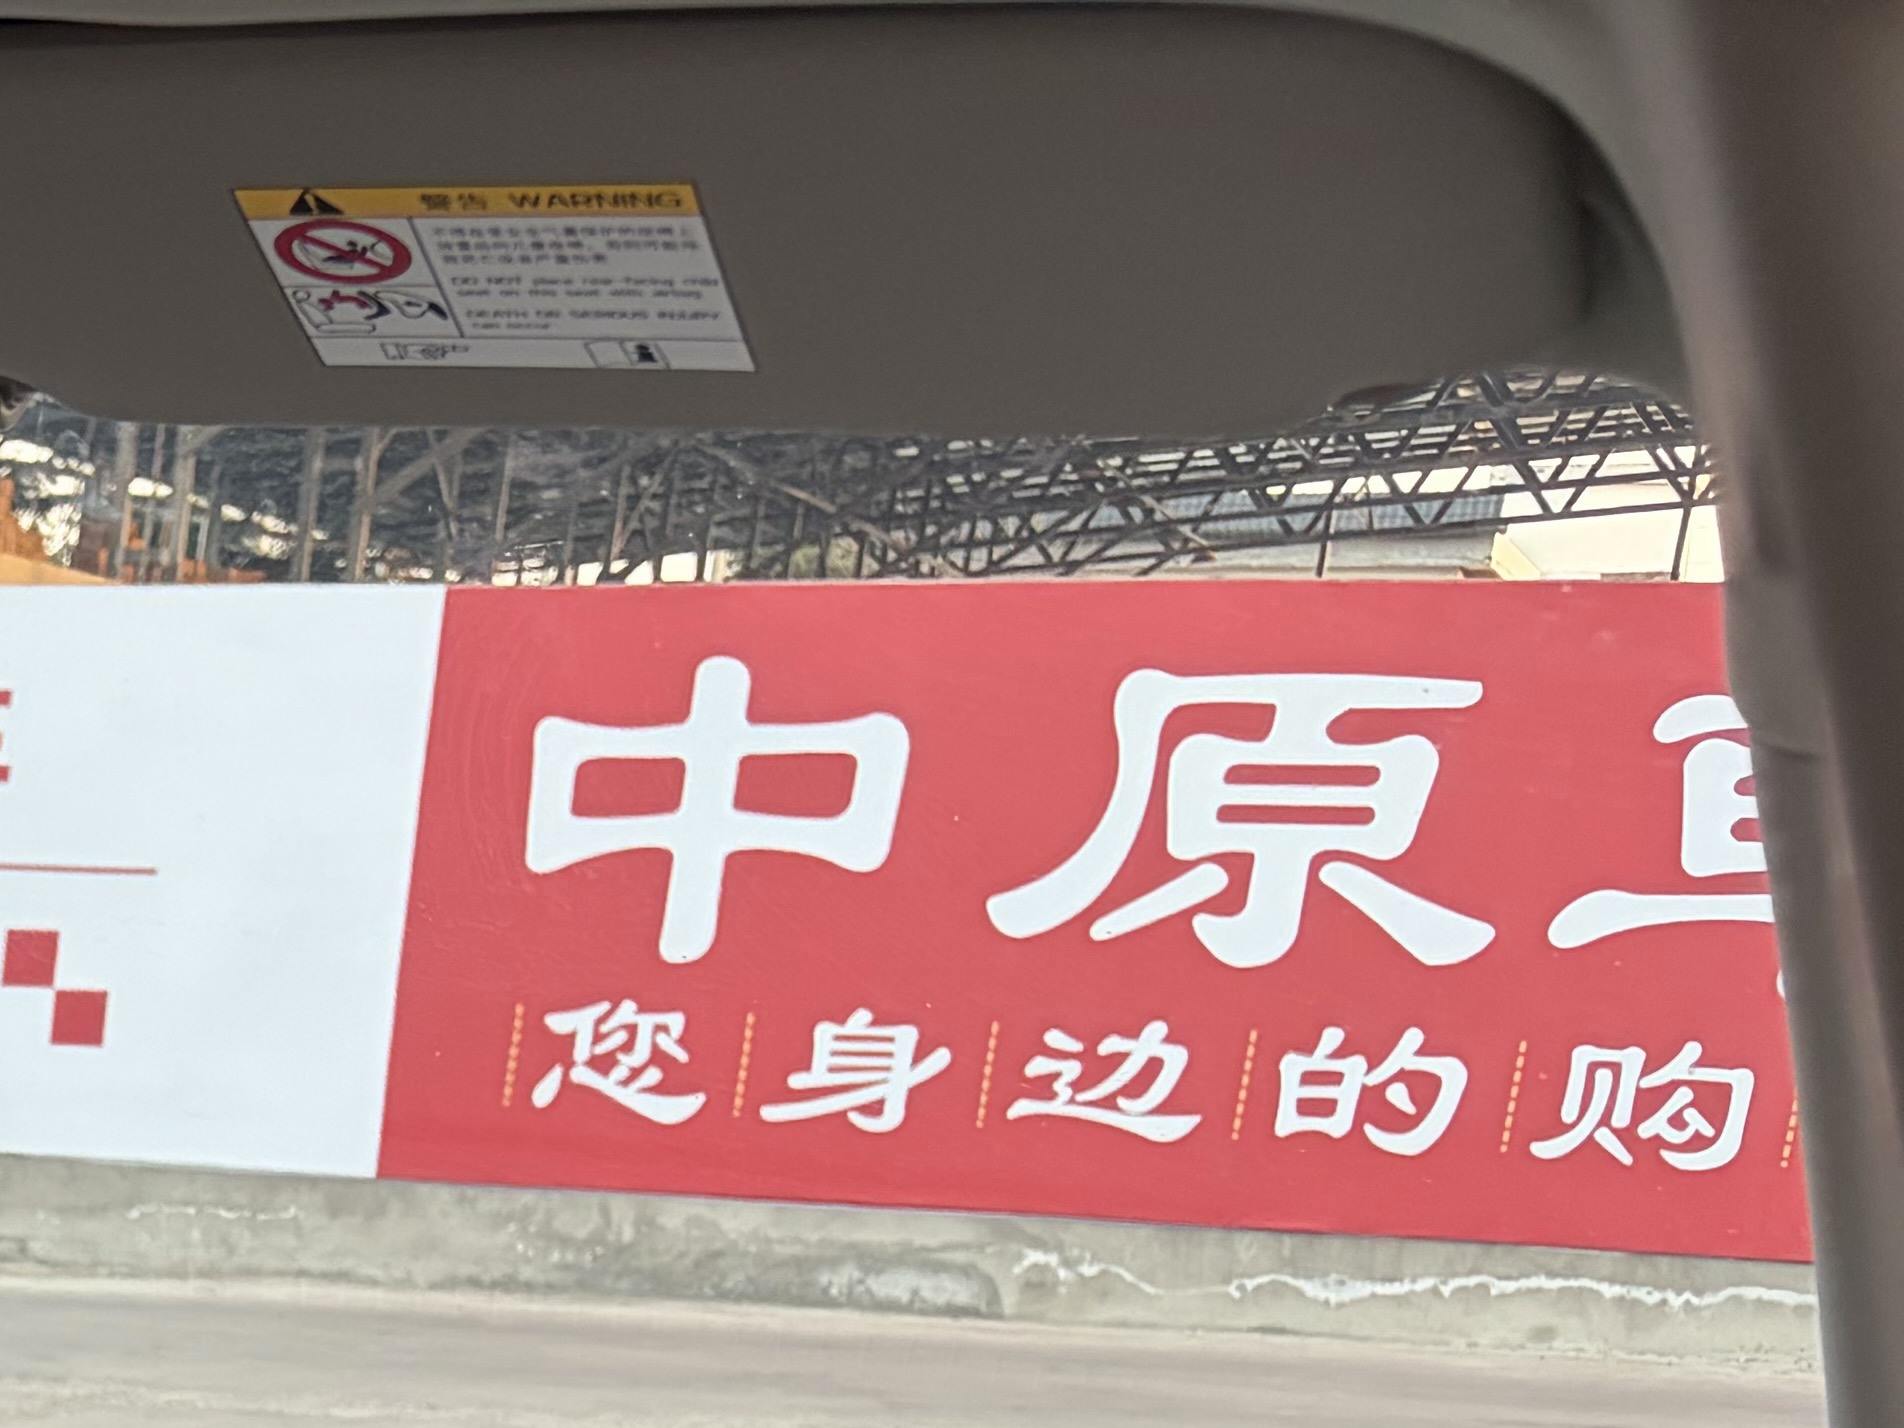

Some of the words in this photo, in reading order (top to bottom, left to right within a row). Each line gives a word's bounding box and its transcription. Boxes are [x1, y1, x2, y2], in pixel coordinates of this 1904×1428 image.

[507, 191, 682, 209] WARNING
[531, 998, 1756, 1173] 您身边的购
